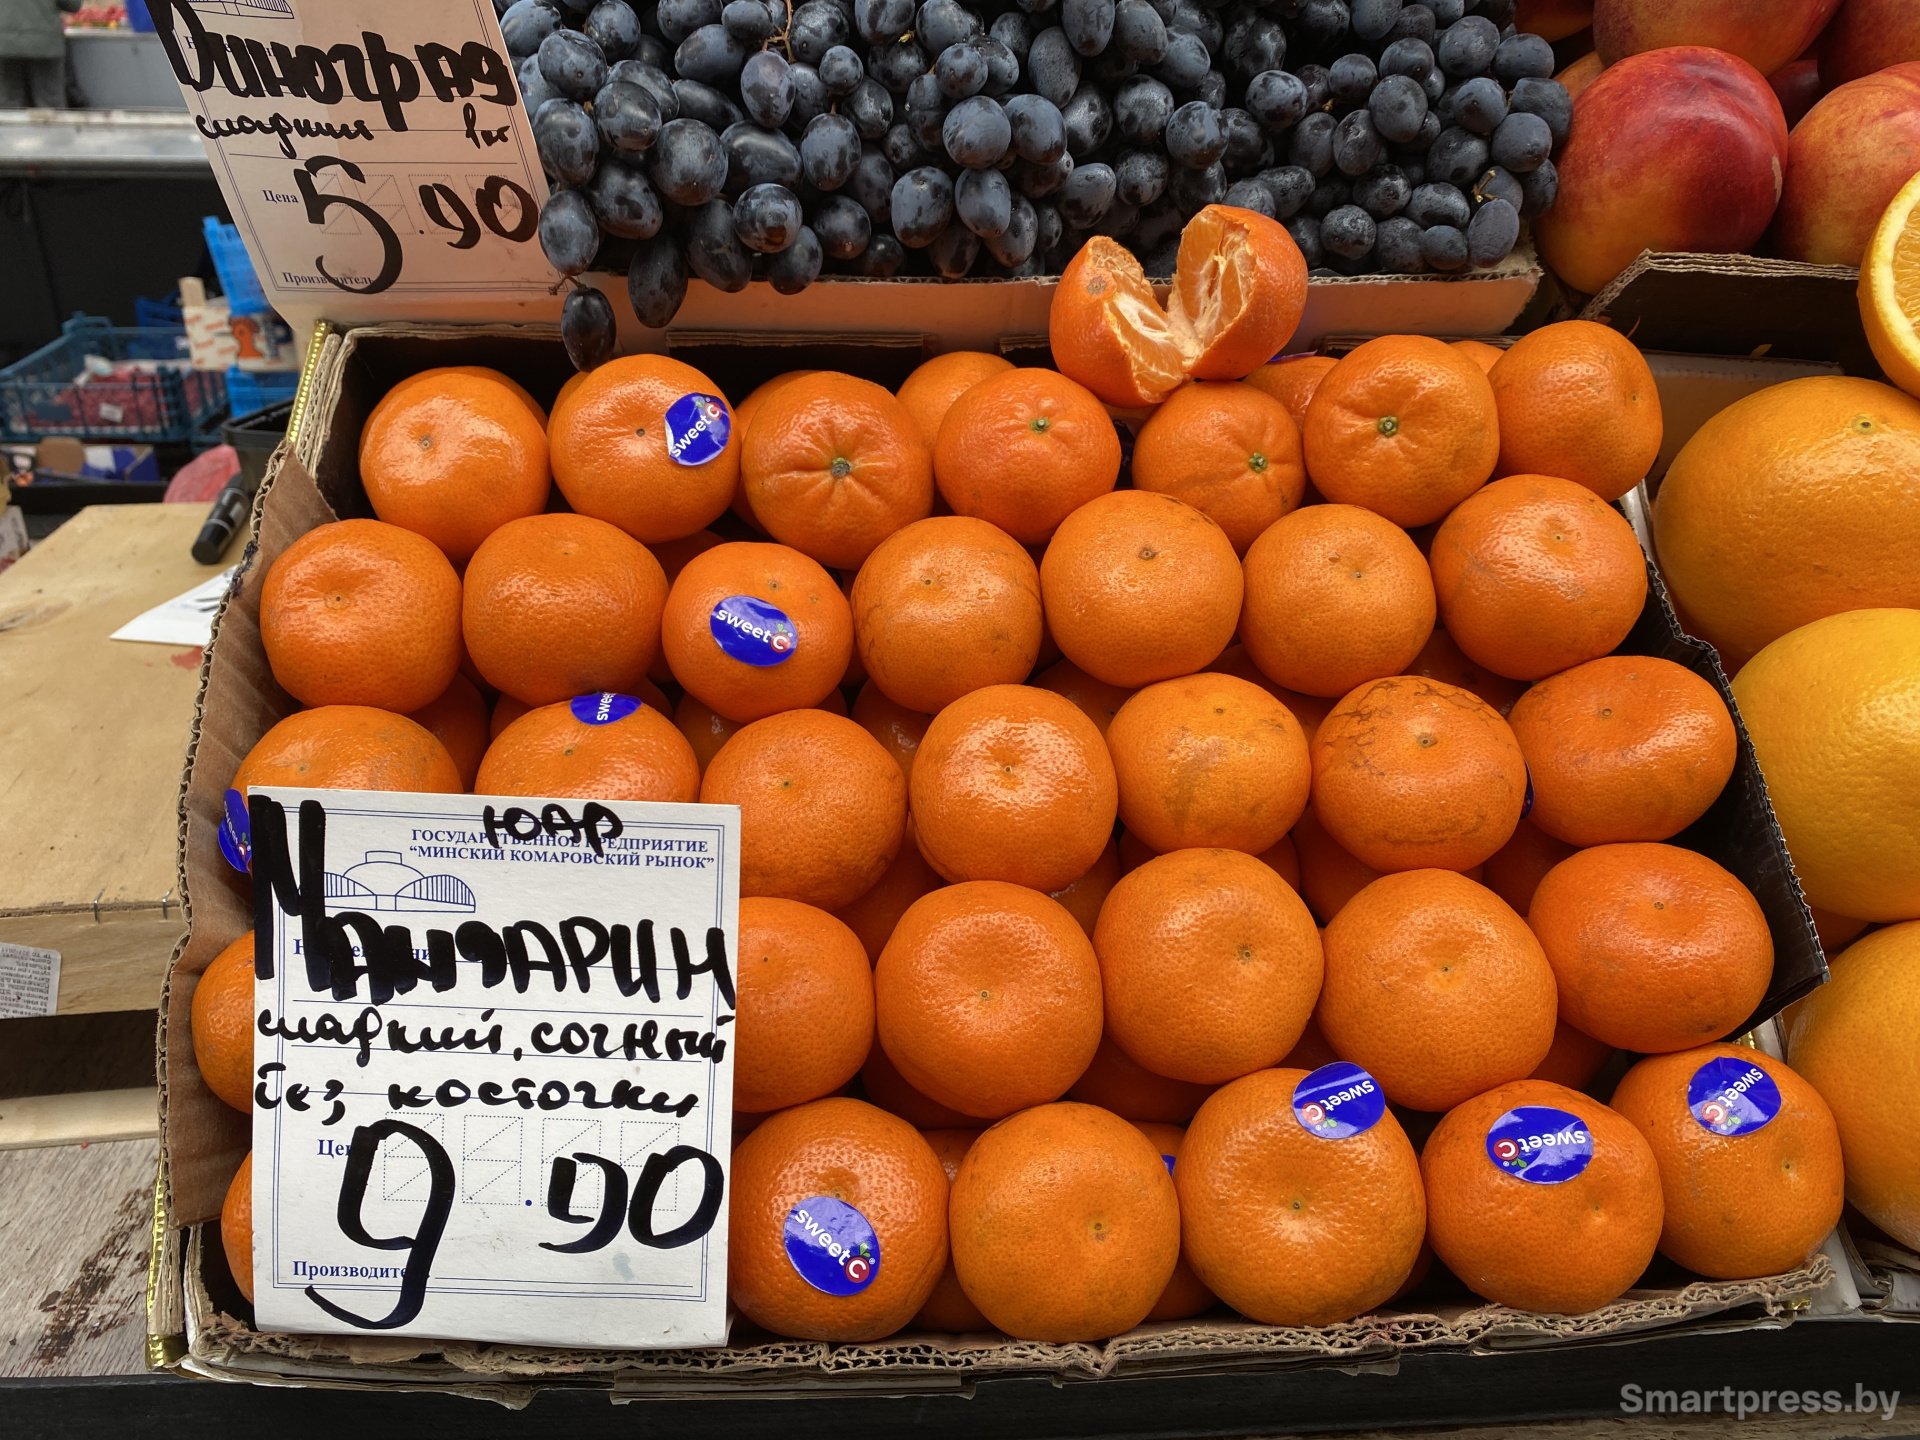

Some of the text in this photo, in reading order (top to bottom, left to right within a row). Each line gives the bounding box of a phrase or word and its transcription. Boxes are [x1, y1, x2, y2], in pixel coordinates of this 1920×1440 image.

[262, 189, 299, 204] Цена
[483, 802, 623, 858] ЮАР
[510, 850, 640, 866] КОМАРОВСКИЙ
